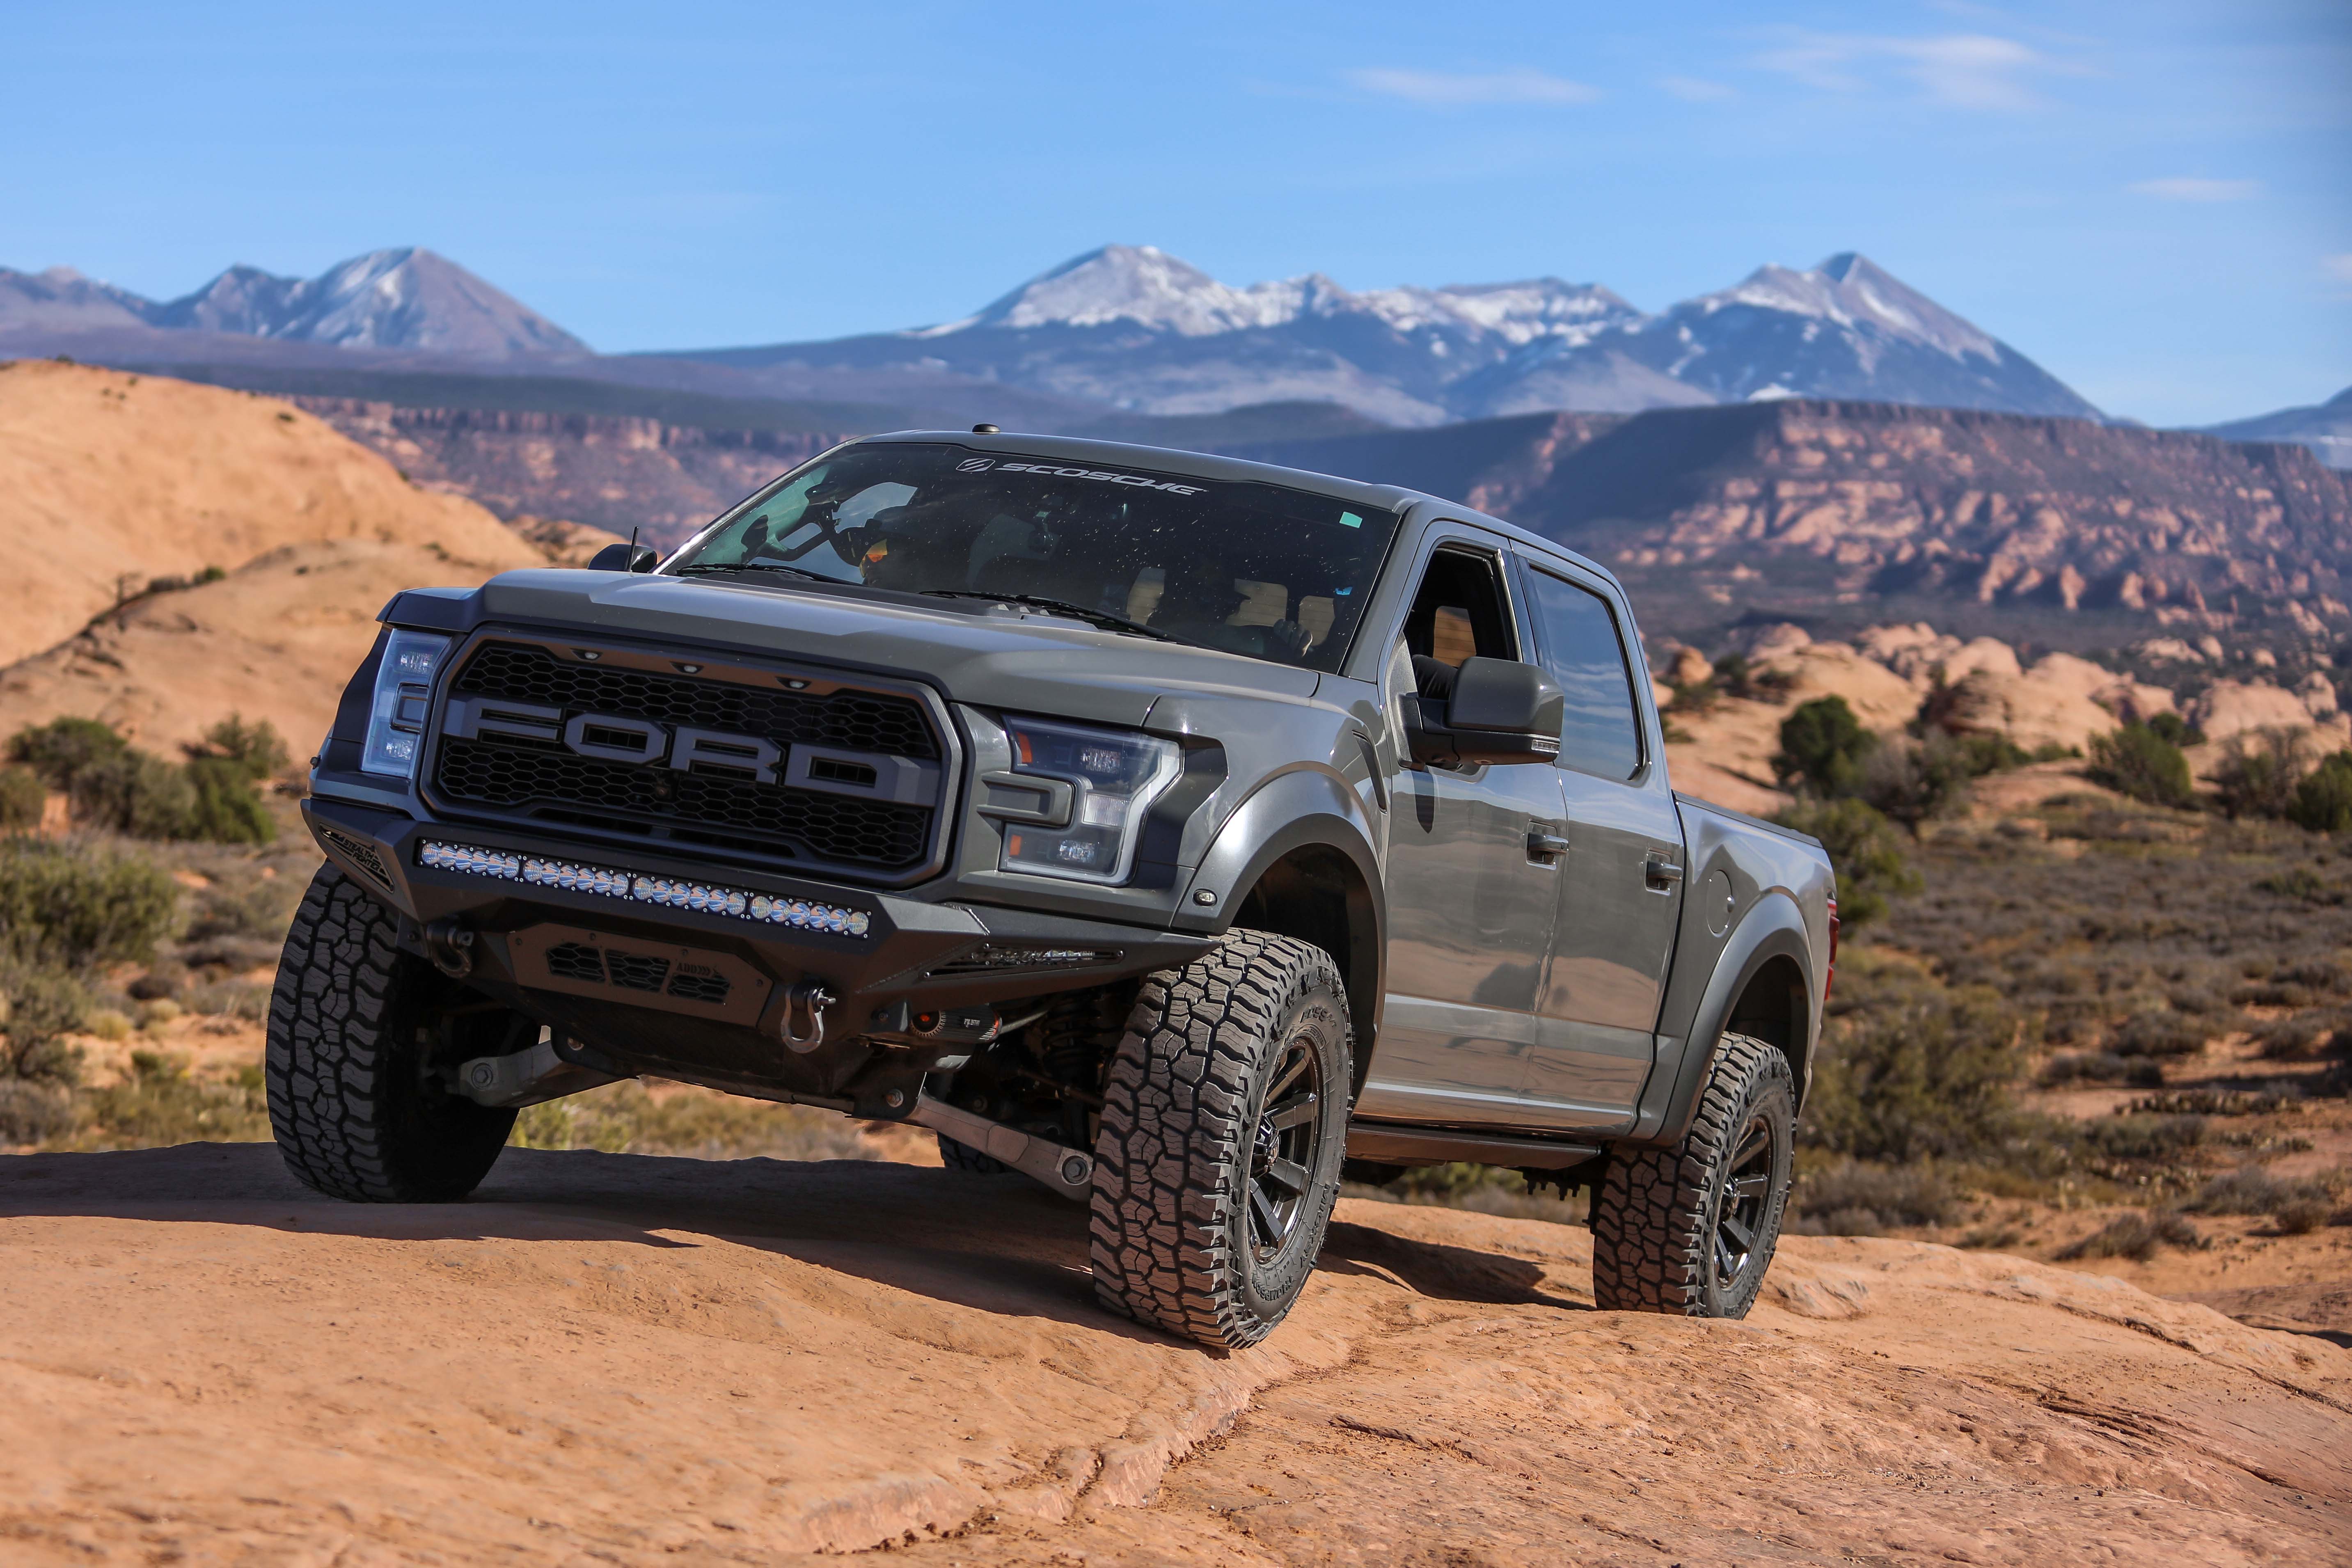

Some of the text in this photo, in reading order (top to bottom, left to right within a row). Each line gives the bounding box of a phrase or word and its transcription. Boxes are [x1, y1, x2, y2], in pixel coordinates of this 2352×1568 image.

[995, 463, 1204, 495] SCOSCHE
[449, 696, 931, 805] FORD
[344, 839, 375, 860] STEALTH
[352, 853, 381, 871] FIGHTER
[676, 962, 697, 973] ADD
[1300, 1183, 1331, 1268] MICKEY
